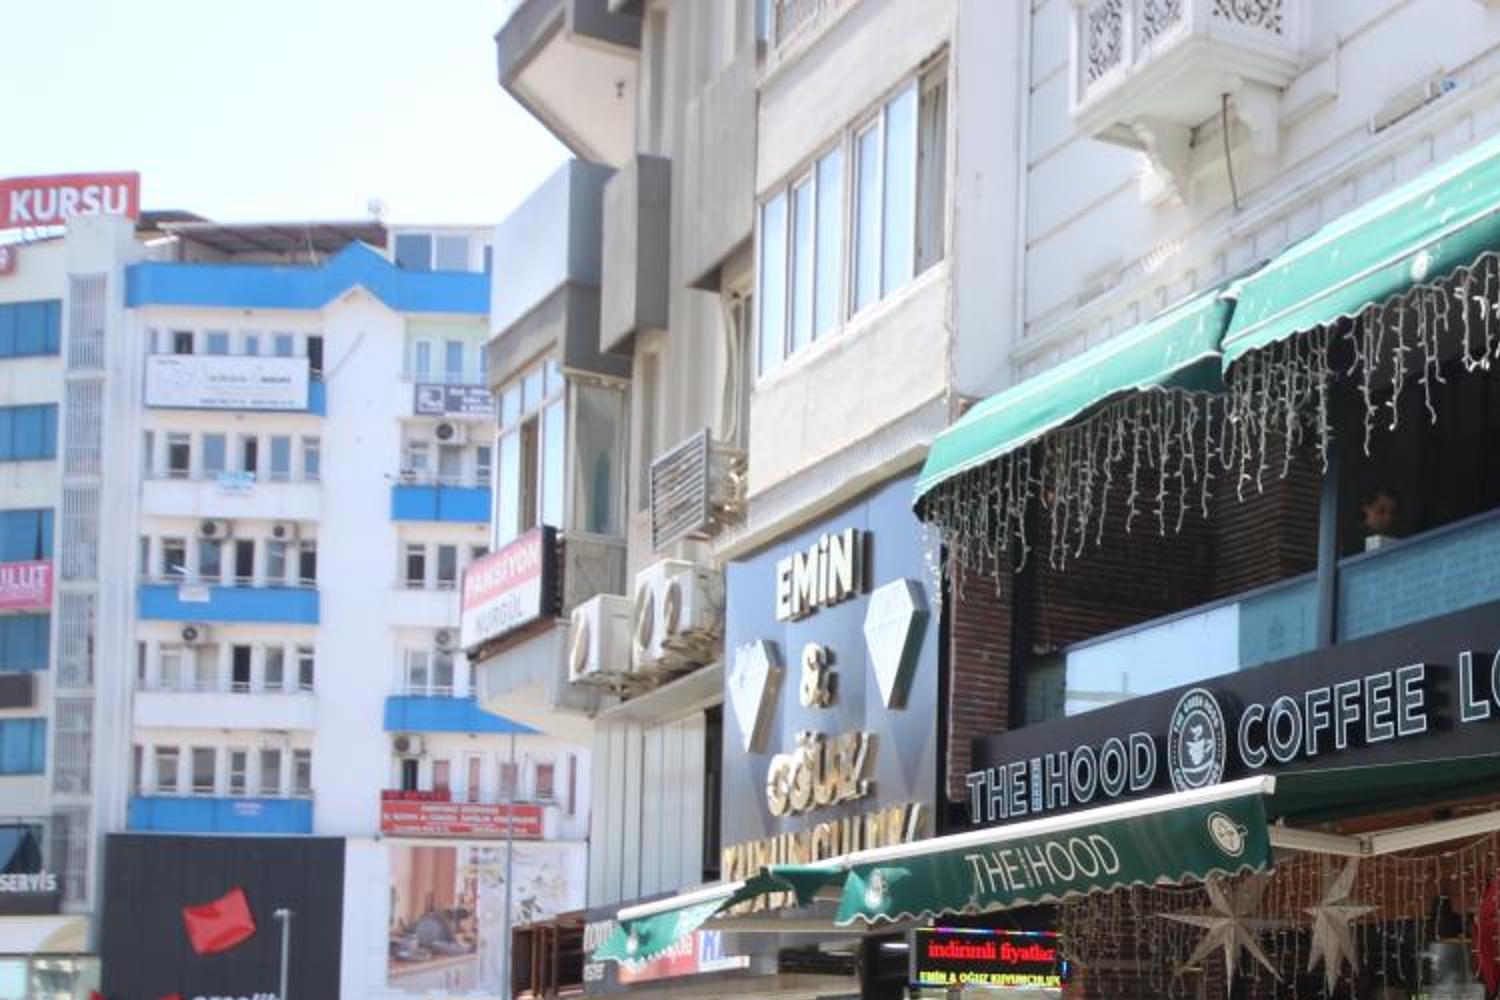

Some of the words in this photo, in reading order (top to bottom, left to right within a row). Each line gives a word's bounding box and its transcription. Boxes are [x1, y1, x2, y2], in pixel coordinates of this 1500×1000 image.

[9, 185, 128, 224] KURSU
[966, 760, 1027, 824] THE
[1045, 732, 1157, 810] HOOD
[1238, 664, 1428, 769] COFFEE
[964, 848, 1026, 895] THE
[1023, 834, 1120, 886] HOOD
[928, 940, 996, 960] indirimli
[1001, 941, 1056, 963] fiyatlar
